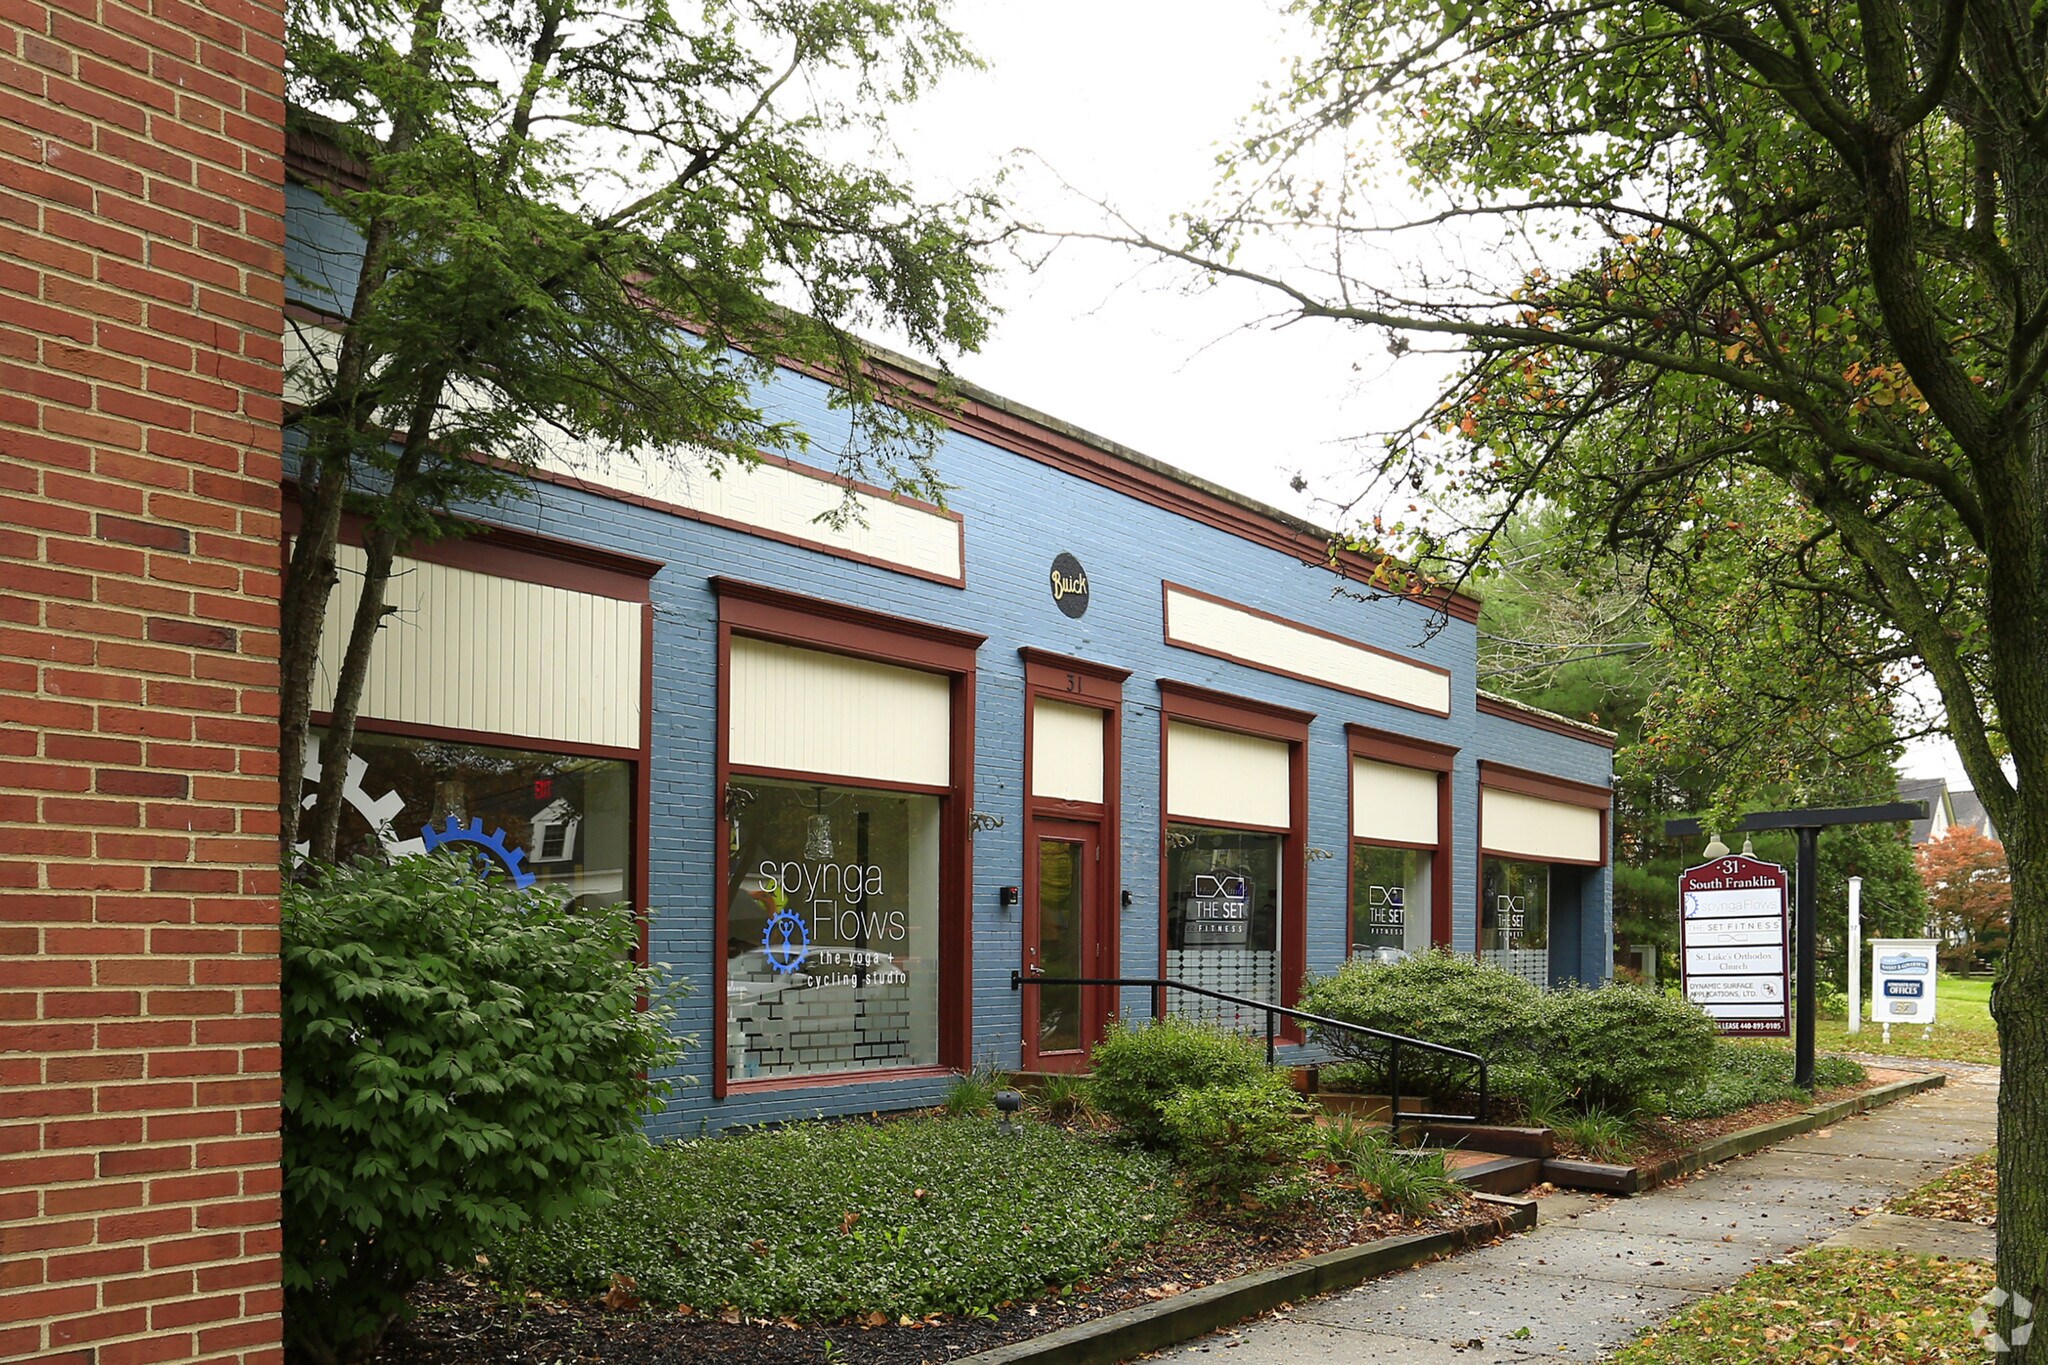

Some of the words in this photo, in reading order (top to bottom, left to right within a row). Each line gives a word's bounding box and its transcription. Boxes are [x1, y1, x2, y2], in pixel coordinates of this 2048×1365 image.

[1051, 569, 1087, 600] Buick
[1066, 673, 1082, 692] 31
[1722, 860, 1739, 874] 31
[758, 860, 884, 904] spynga
[1689, 878, 1722, 890] South
[1725, 876, 1775, 888] Franklin
[1196, 901, 1219, 918] THE
[1222, 902, 1244, 919] SET
[1370, 907, 1386, 922] THE
[1388, 908, 1404, 923] SET
[812, 899, 906, 941] Flows
[1497, 913, 1511, 927] THE
[1511, 914, 1524, 927] SET
[1707, 923, 1723, 931] SET
[1727, 922, 1779, 930] FITNESS
[1198, 924, 1243, 932] FITNESS
[820, 951, 841, 964] the
[849, 952, 879, 966] yoga
[887, 953, 894, 963] +
[1695, 953, 1705, 961] St.
[1734, 952, 1772, 960] Orthodox
[1719, 962, 1748, 970] Church
[807, 971, 858, 989] cycling
[865, 971, 906, 985] studio
[1889, 987, 1918, 995] OFFICES
[1722, 1022, 1739, 1030] LEASE
[1740, 1022, 1781, 1030] 440-893-0105
